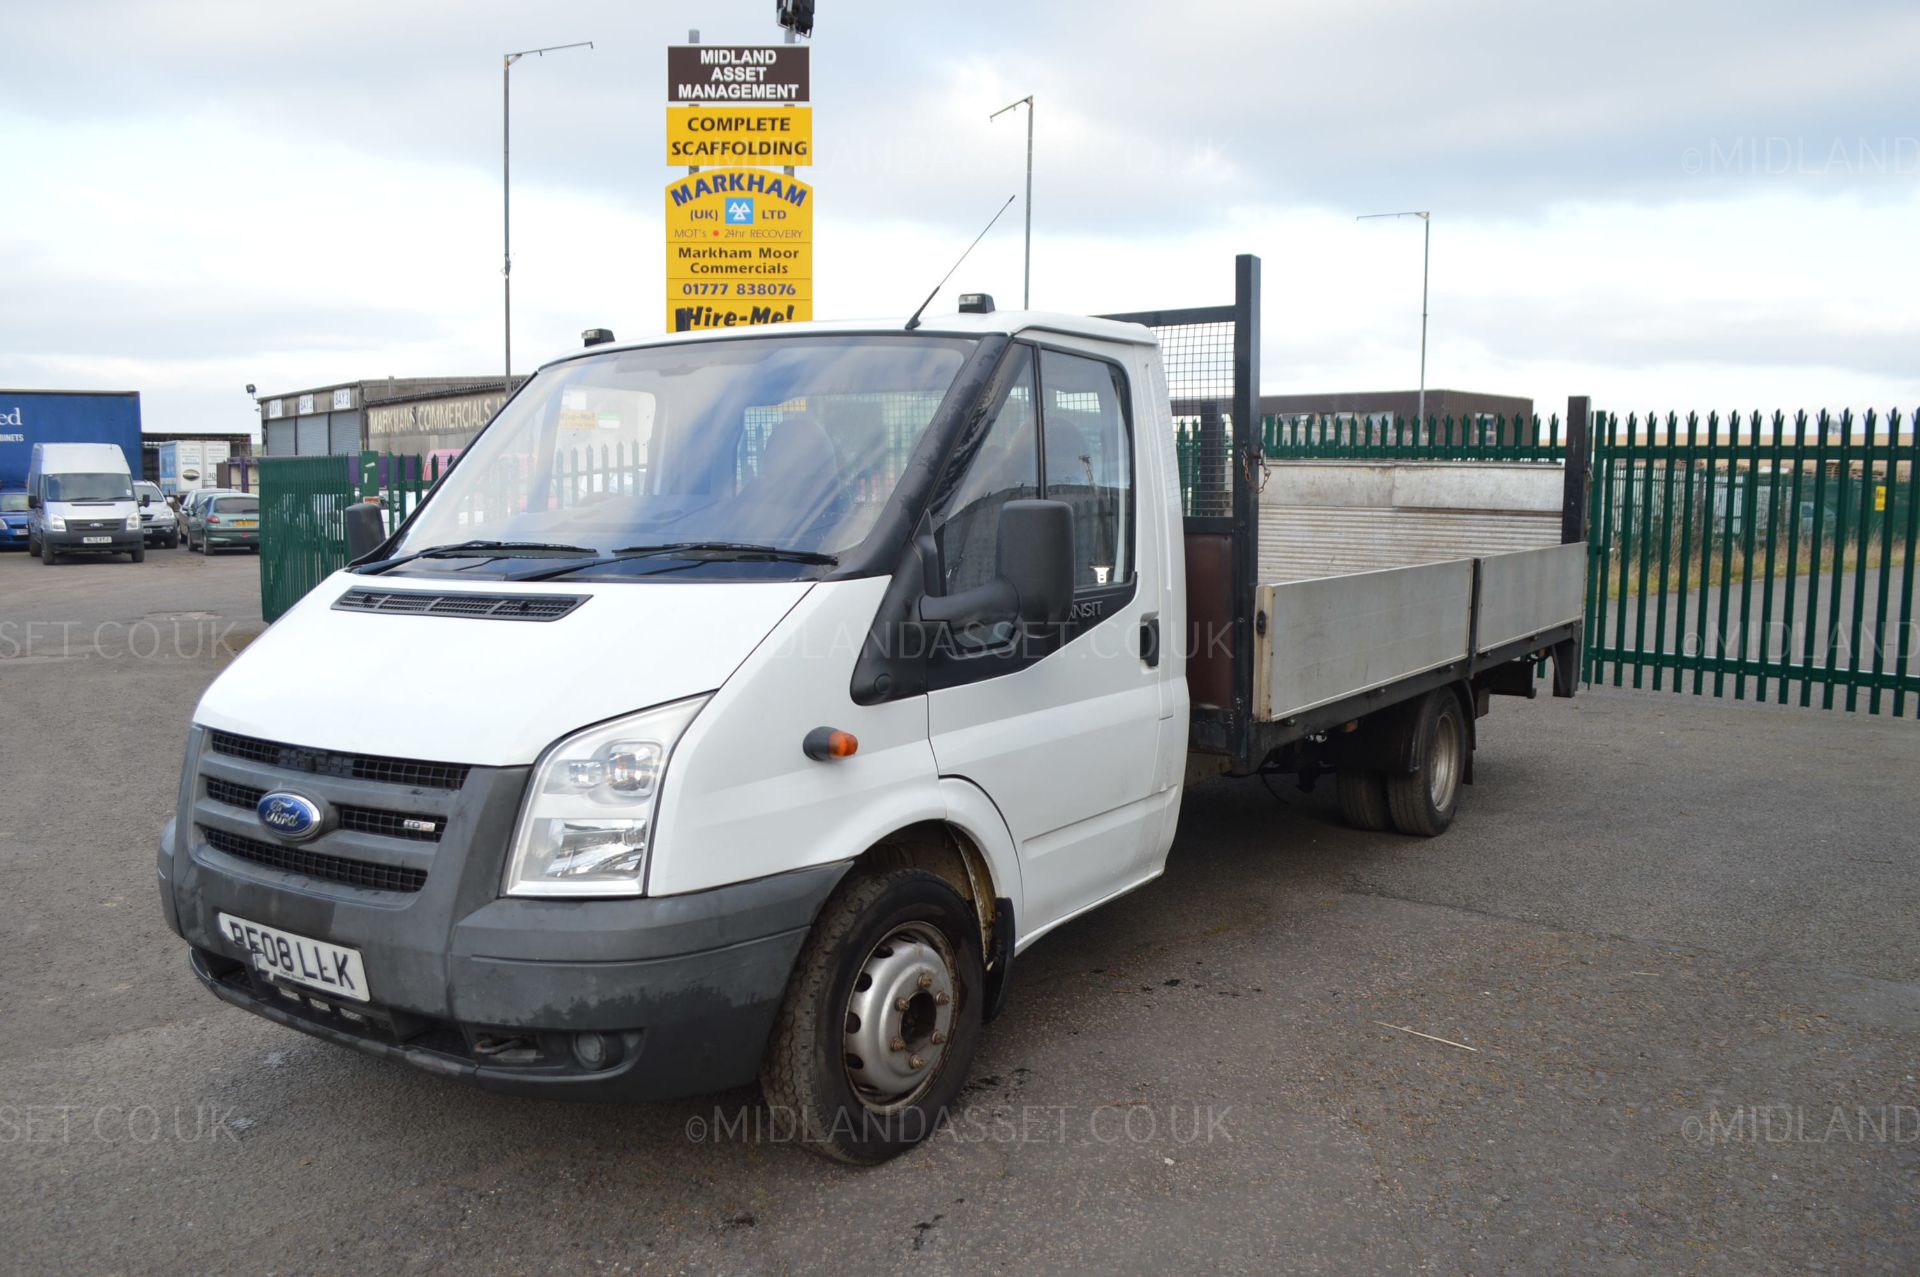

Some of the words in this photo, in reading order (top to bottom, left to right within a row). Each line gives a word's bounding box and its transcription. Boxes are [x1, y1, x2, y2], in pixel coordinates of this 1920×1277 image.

[700, 50, 777, 65] MIDLAND
[710, 66, 767, 82] ASSET
[678, 83, 799, 99] MANAGEMENT
[687, 116, 791, 132] COMPLETE
[671, 140, 808, 156] SCAFFOLDING
[670, 172, 808, 207] MARKHAM
[690, 209, 718, 221] (UK)
[762, 210, 787, 220] LTD
[724, 229, 745, 239] 24hr
[750, 229, 803, 239] RECOVERY
[678, 247, 752, 259] Markham
[759, 247, 799, 259] Moor
[690, 262, 788, 274] Commercials
[682, 283, 729, 296] 01777
[736, 283, 796, 296] 838076
[418, 400, 491, 431] COMMERCIALS
[266, 800, 300, 827] Ford
